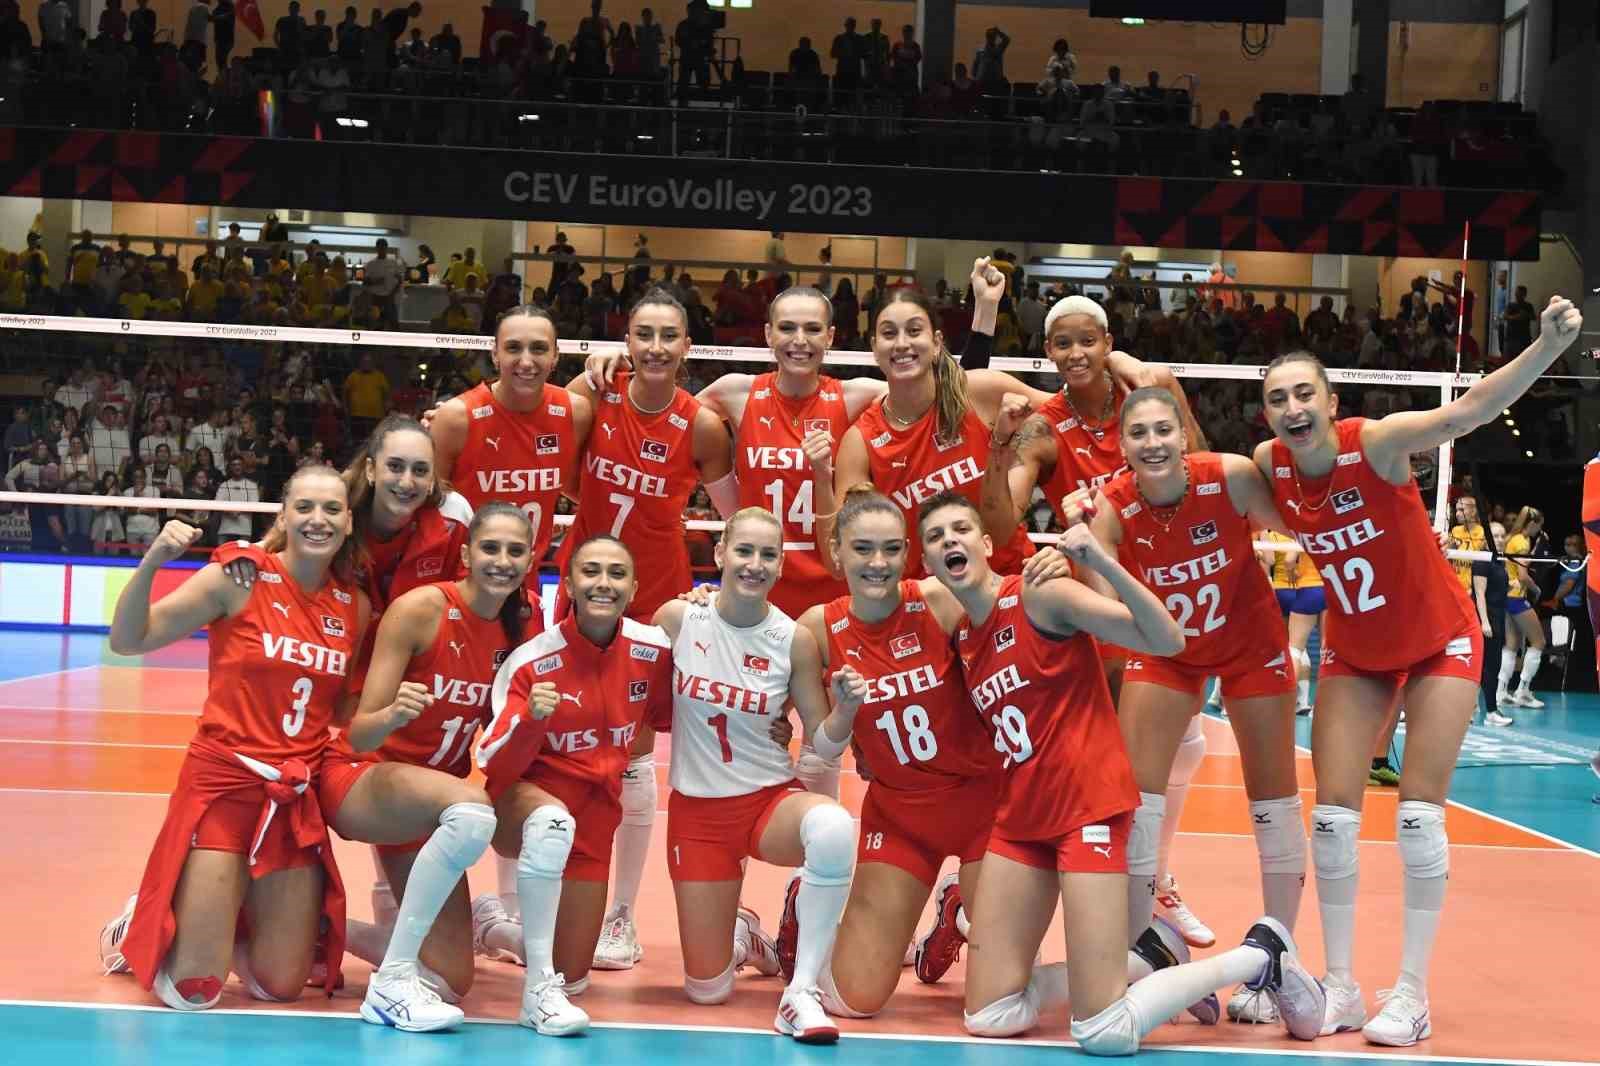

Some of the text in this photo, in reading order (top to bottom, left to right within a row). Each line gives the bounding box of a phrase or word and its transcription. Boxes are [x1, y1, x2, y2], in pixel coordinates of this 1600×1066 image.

[503, 171, 872, 220] CEV EuroVolley 2023
[435, 336, 450, 344] CEV
[476, 467, 563, 493] VESTEL
[587, 451, 669, 498] VESTEL
[747, 447, 835, 471] VEST
[892, 456, 985, 509] VESTEL
[609, 492, 635, 540] 7
[765, 479, 816, 535] 14
[1138, 548, 1232, 587] VESTEL
[1320, 557, 1386, 614] 12
[1166, 583, 1227, 637] 22
[262, 632, 347, 677] VESTEL
[282, 677, 313, 737] 3
[434, 673, 492, 707] VEST
[675, 670, 770, 716] VESTEL
[863, 664, 944, 705] ESTEL
[428, 716, 481, 768] 11
[708, 713, 733, 763] 1
[876, 704, 938, 766] 18
[673, 845, 680, 865] 1
[866, 832, 884, 850] 18
